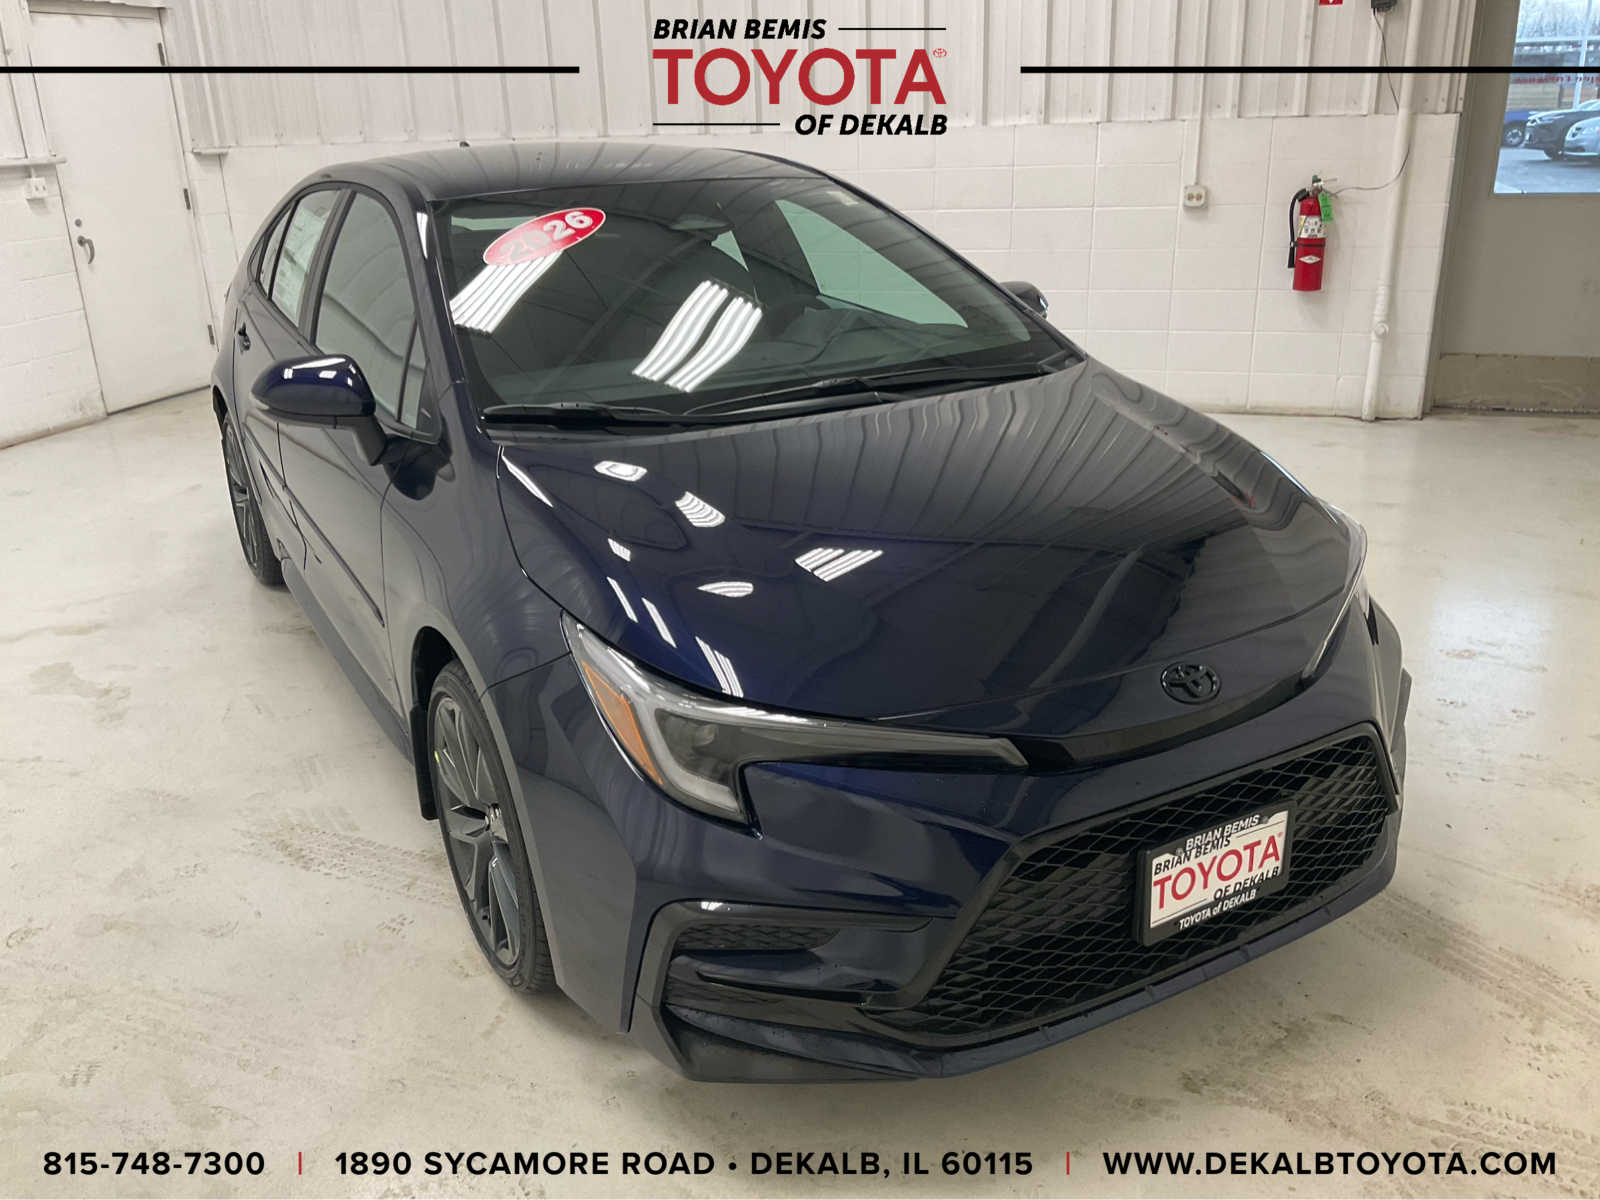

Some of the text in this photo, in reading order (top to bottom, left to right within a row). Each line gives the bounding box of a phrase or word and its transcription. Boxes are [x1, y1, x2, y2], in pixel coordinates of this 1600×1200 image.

[500, 211, 593, 261] 2026
[1185, 814, 1260, 851] BRIAN BEMIS
[1153, 835, 1281, 909] TOYOTA
[1154, 837, 1231, 876] BRIAN BEMIS
[1213, 866, 1280, 901] OF DEKALB
[1178, 888, 1257, 931] TOYOTA of DEKALB
